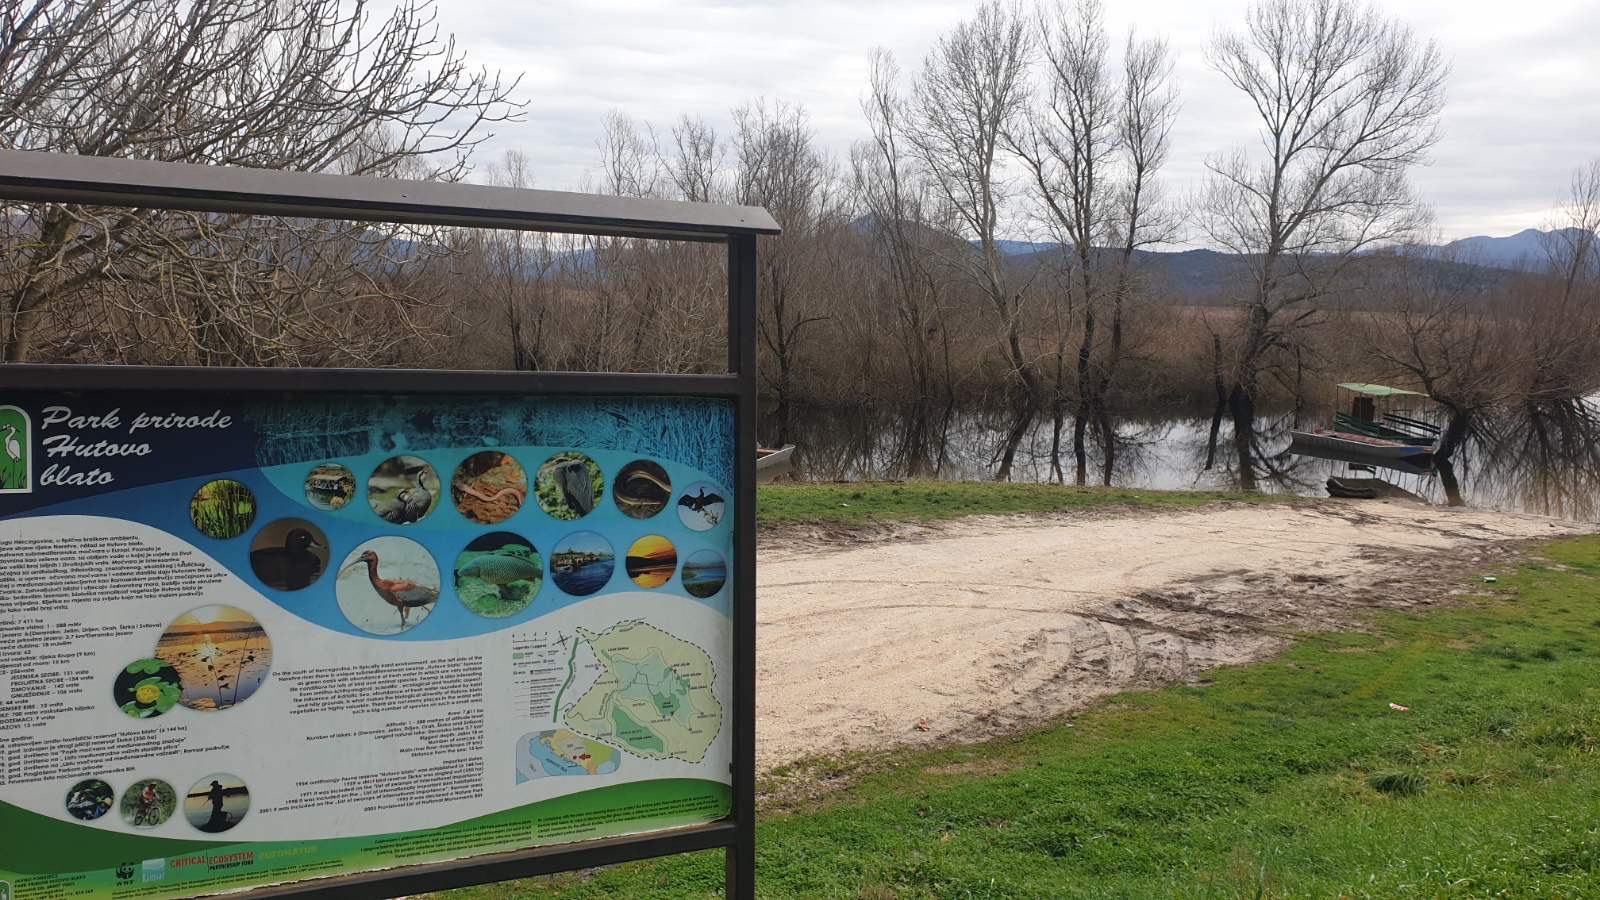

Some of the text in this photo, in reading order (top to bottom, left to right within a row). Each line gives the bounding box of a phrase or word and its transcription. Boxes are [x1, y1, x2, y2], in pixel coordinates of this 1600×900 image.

[41, 405, 232, 434] Park prirode
[42, 434, 152, 458] Hutovo
[40, 463, 115, 486] blato
